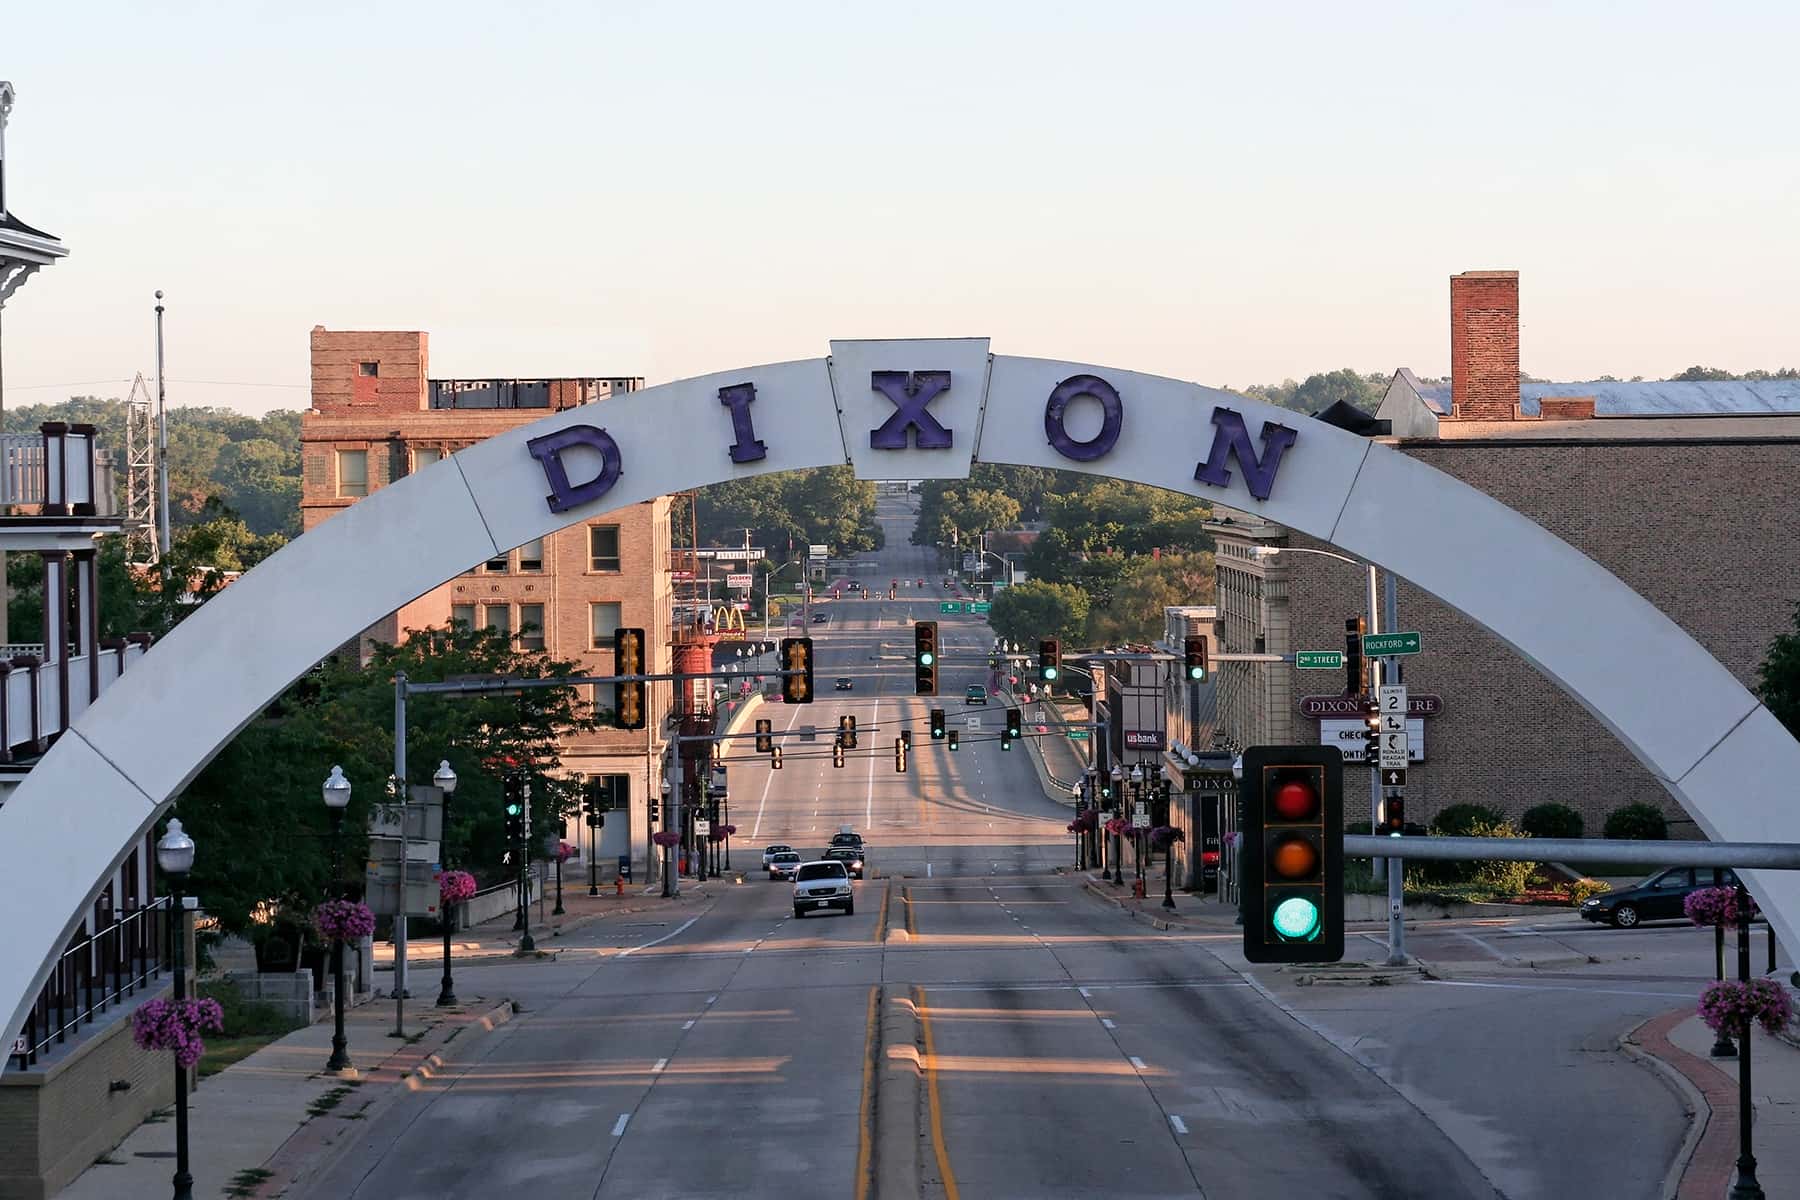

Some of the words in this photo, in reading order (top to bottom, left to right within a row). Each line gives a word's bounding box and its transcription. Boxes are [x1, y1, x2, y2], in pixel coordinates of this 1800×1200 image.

[526, 371, 1298, 514] DIXON
[1366, 640, 1403, 650] ROCKFORD
[1313, 656, 1339, 664] STREET
[1310, 701, 1359, 712] DIXON
[1389, 696, 1398, 710] 2
[1192, 779, 1233, 789] DIXO
